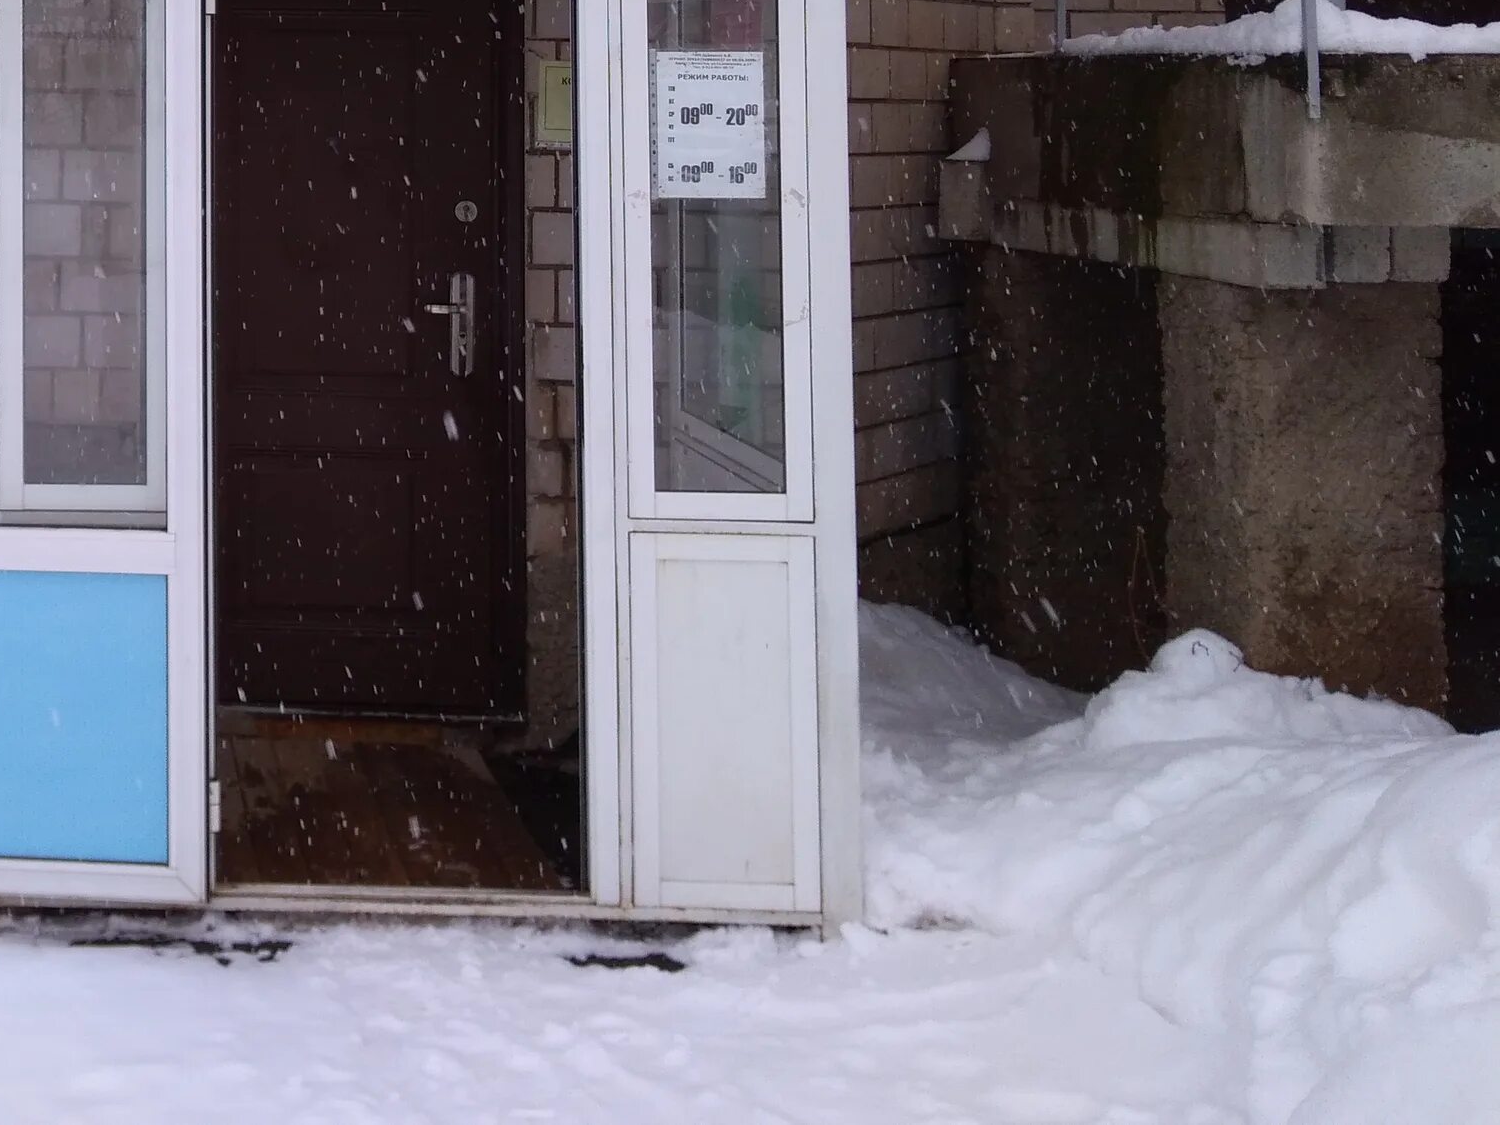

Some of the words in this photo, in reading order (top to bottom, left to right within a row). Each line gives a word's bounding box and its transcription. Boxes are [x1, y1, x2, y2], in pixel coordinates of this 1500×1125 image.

[561, 77, 571, 85] К
[677, 73, 709, 81] РЕЖИМ
[711, 74, 749, 82] РАБОТЫ:
